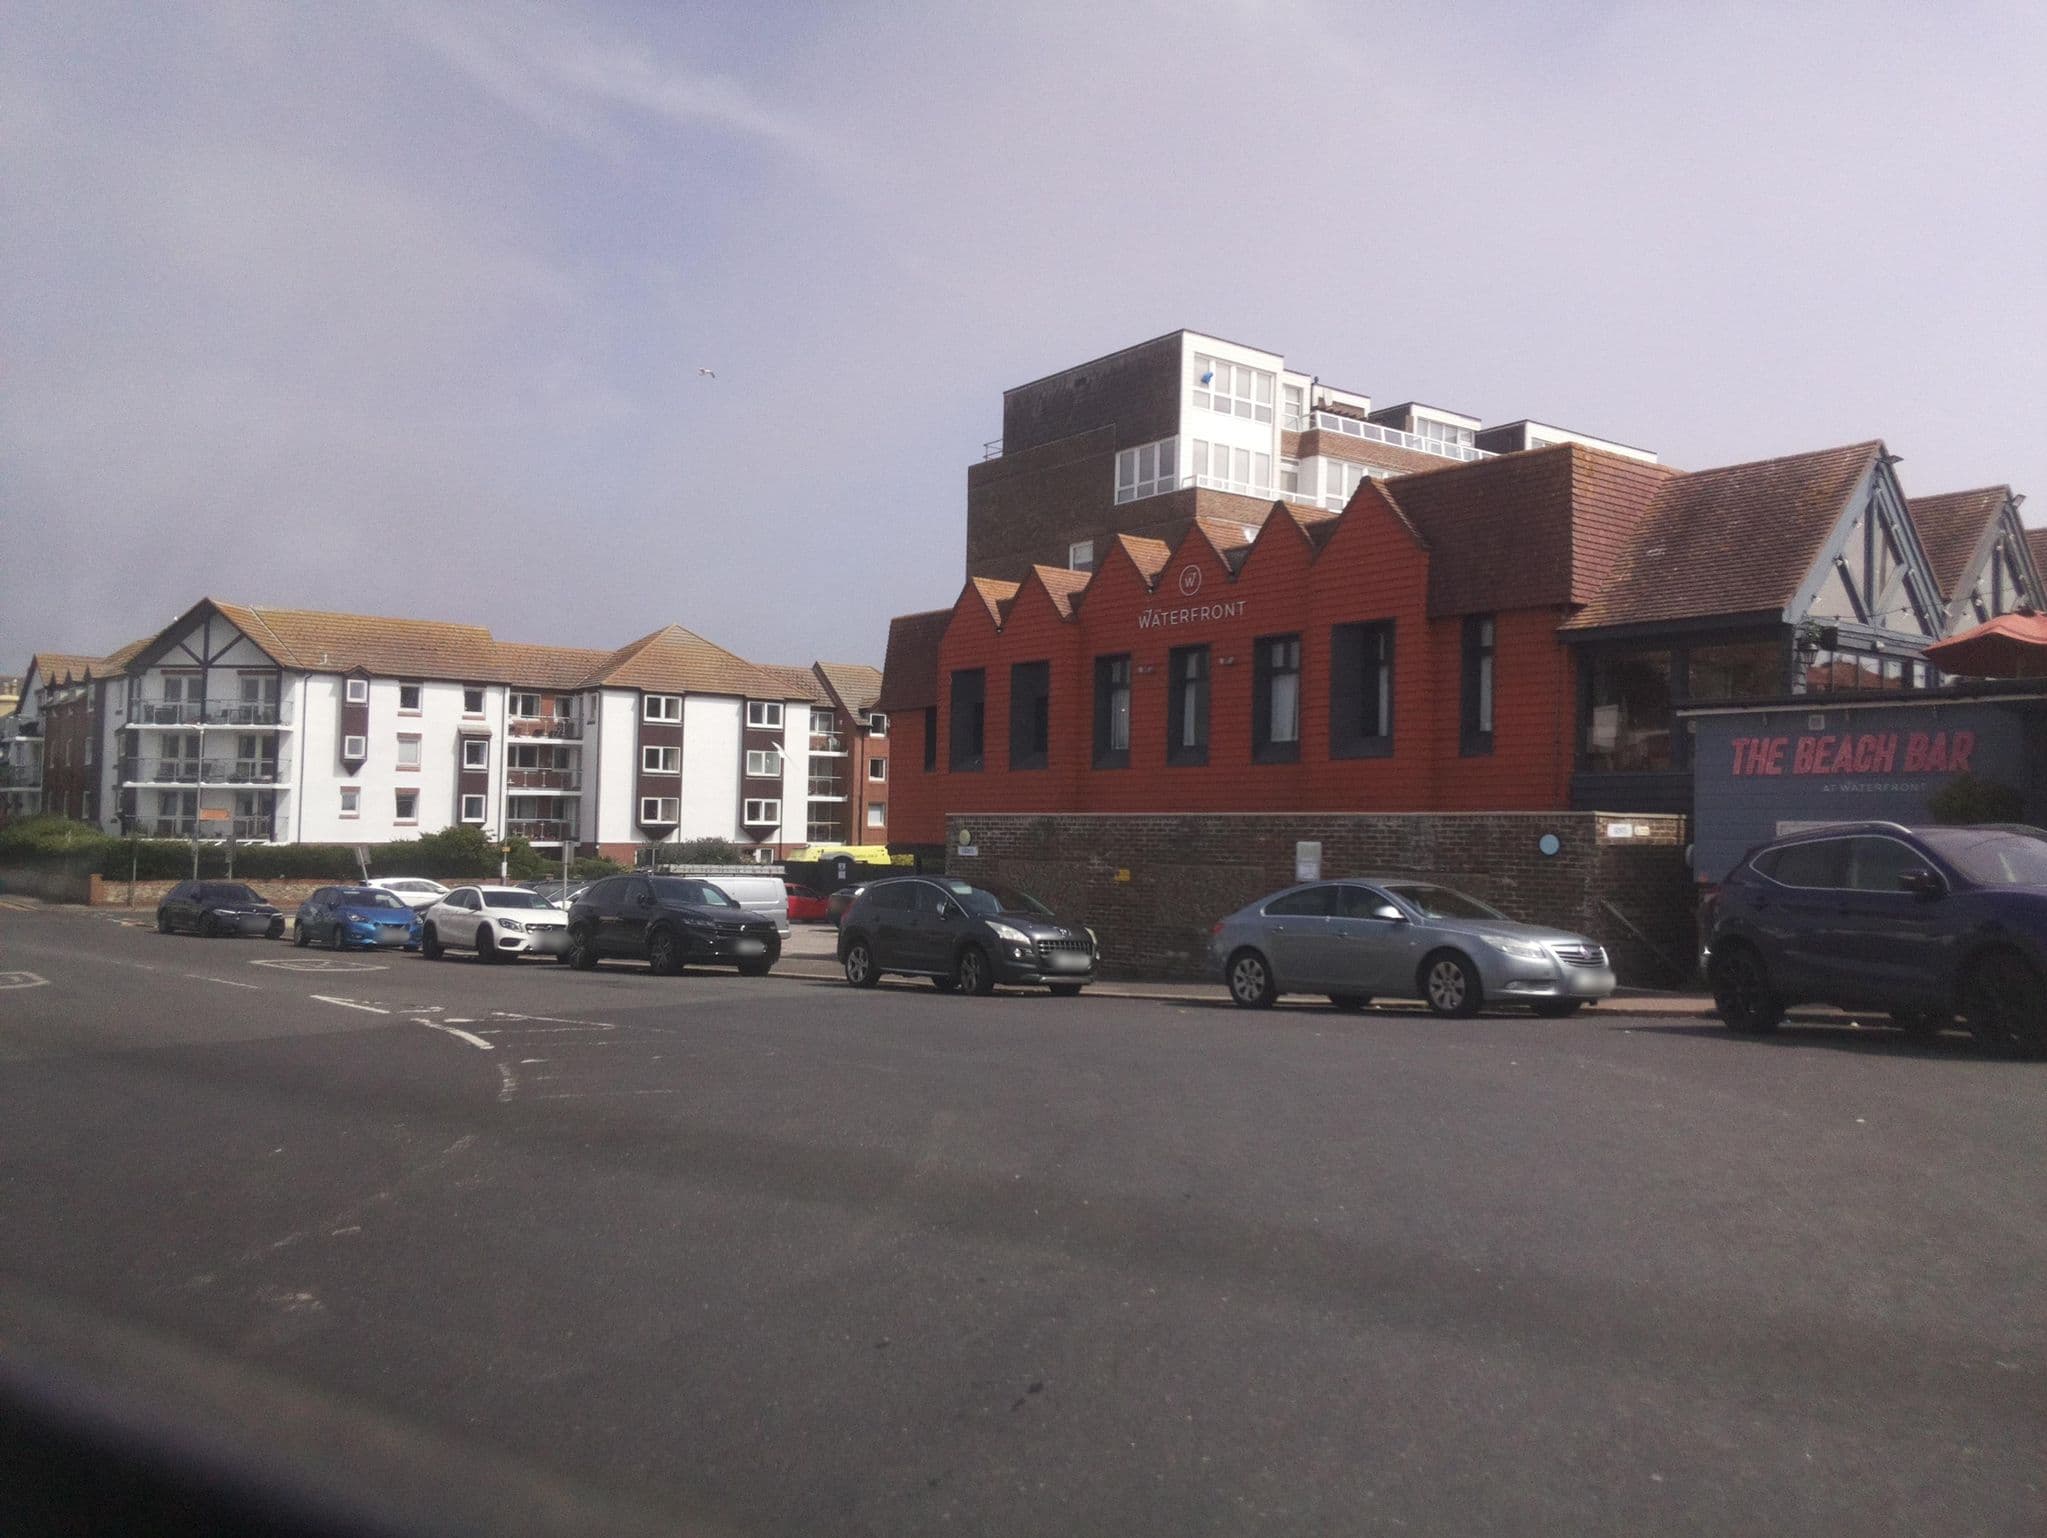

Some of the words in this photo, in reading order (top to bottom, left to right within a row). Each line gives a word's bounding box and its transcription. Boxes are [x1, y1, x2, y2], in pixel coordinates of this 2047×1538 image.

[1138, 601, 1247, 629] WATERFRONT
[1731, 736, 1790, 776] THE
[1792, 734, 1900, 775] BEACH
[1902, 731, 1976, 774] BAR
[1839, 782, 1928, 793] WATERFRONT
